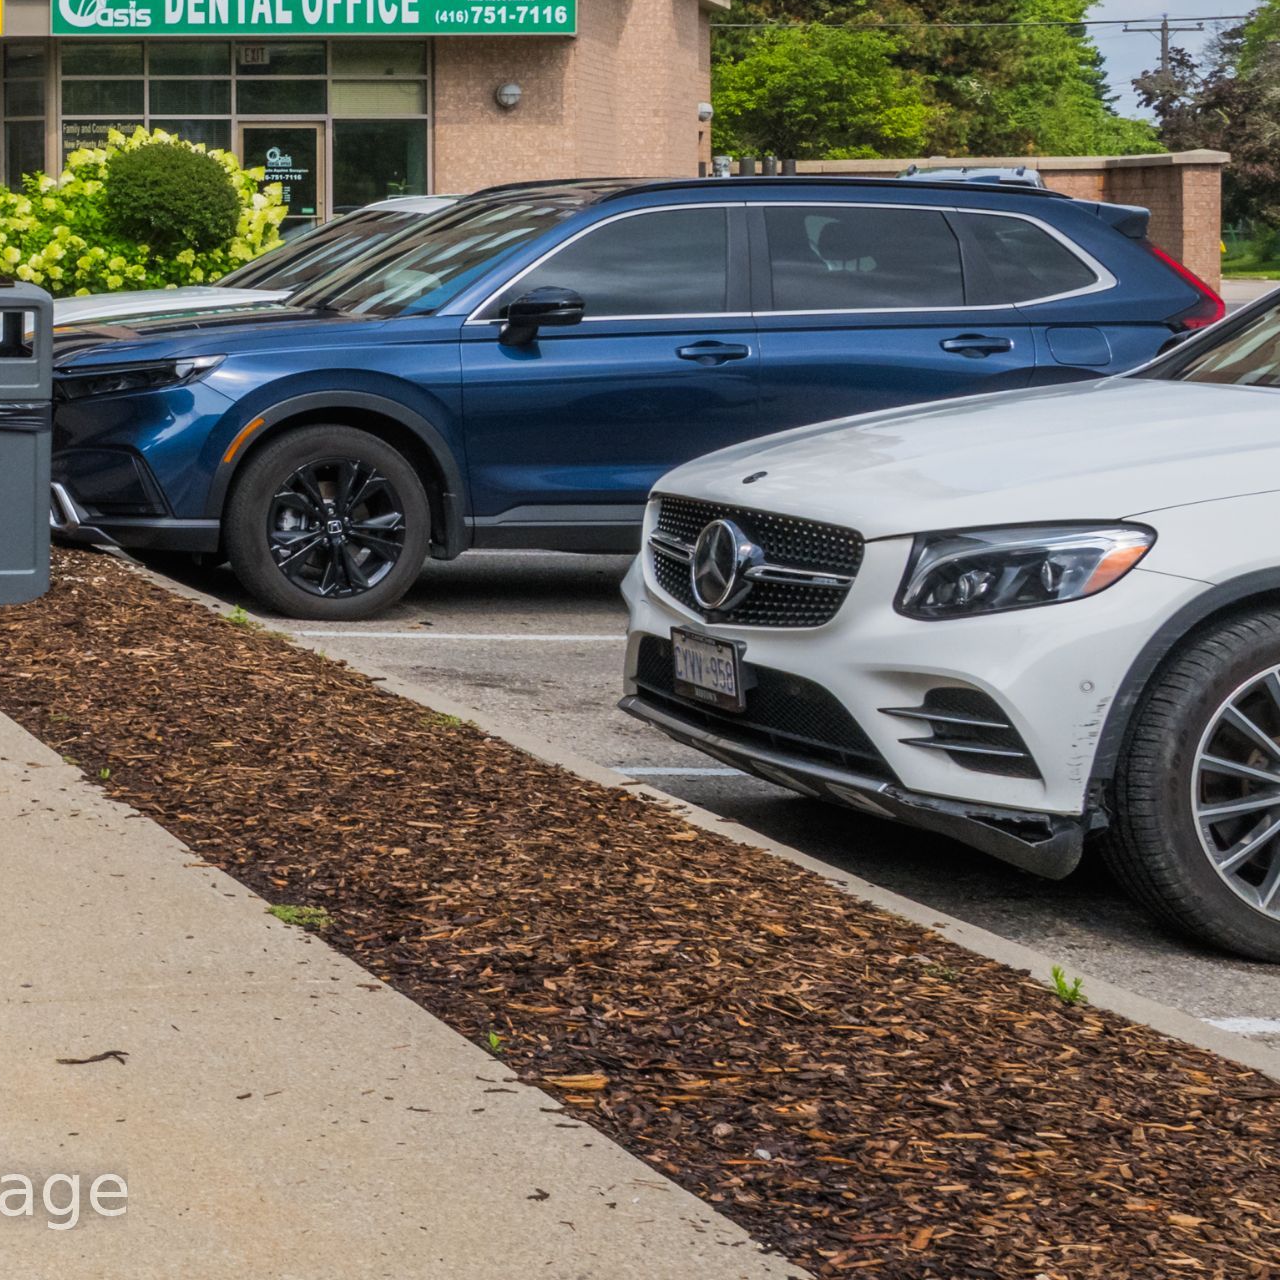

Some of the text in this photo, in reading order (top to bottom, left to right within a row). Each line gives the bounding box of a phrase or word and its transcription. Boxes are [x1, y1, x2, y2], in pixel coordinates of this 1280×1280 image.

[435, 5, 568, 25] (416) 751-7116
[244, 47, 266, 63] EXIT
